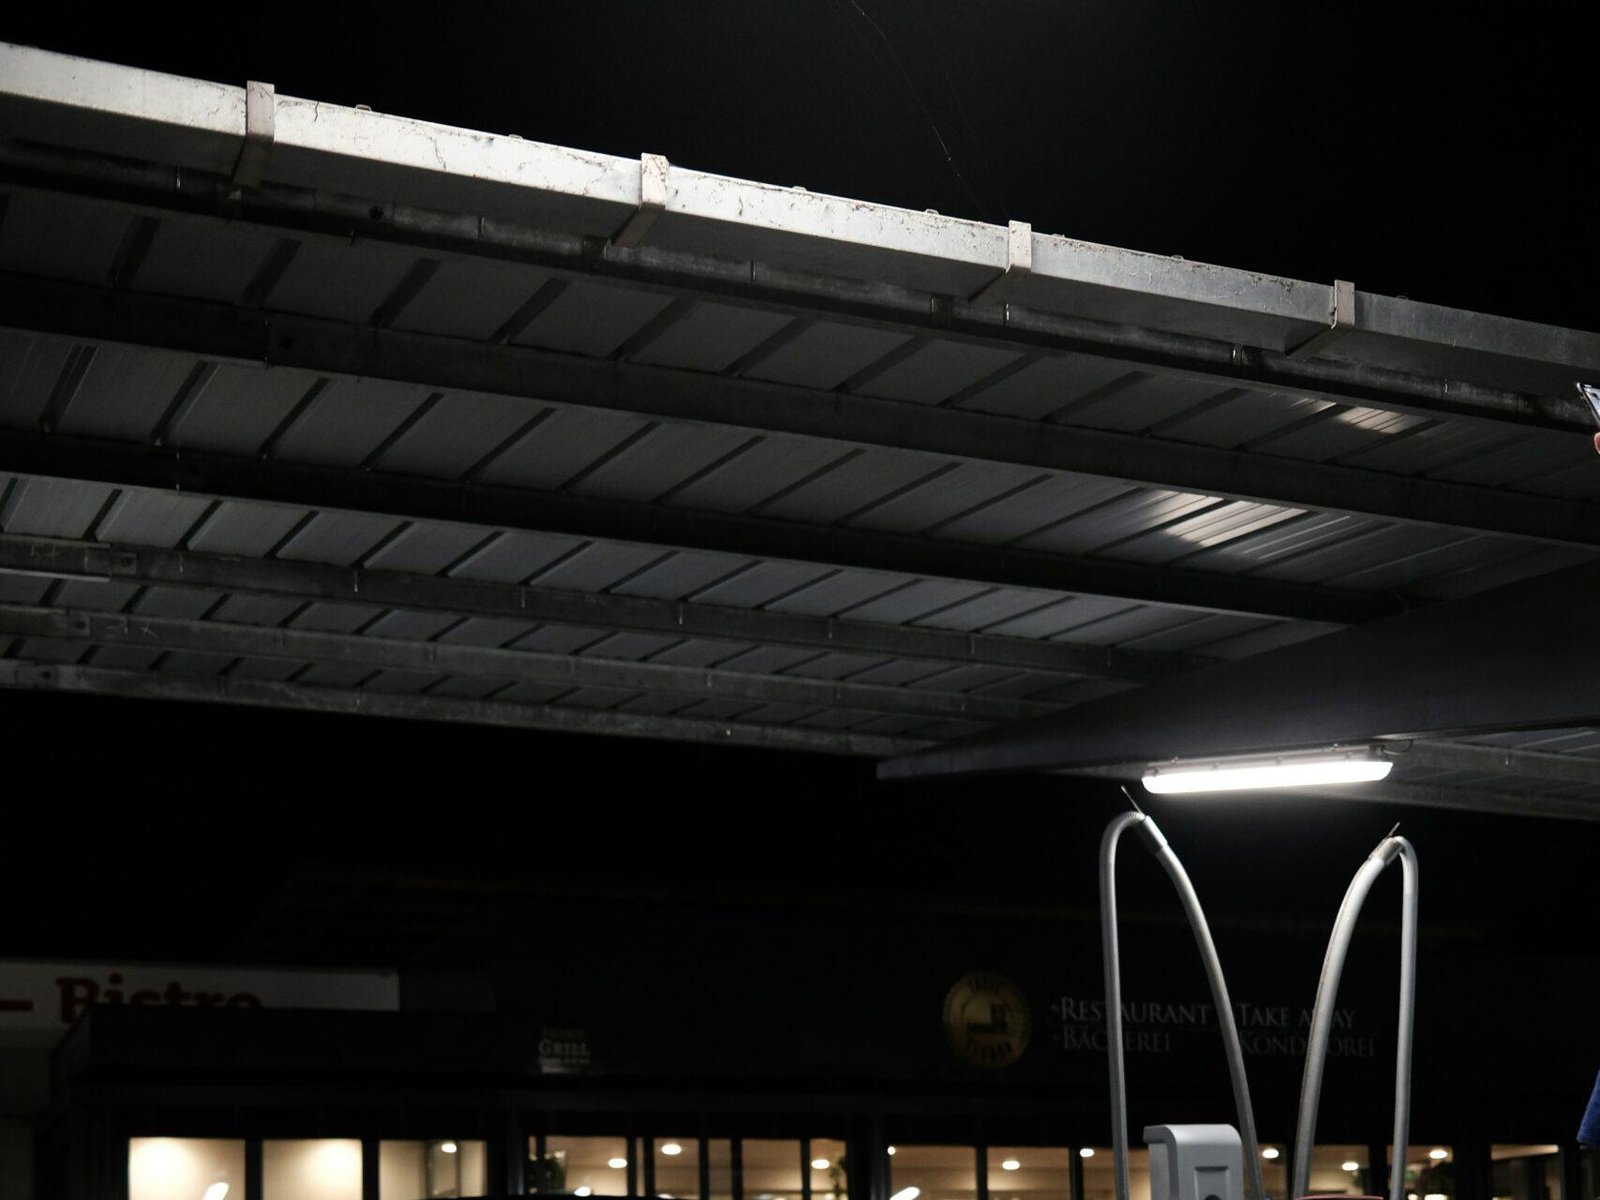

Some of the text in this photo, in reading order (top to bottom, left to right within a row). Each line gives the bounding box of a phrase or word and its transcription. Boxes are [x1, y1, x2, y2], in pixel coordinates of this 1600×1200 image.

[1061, 996, 1356, 1030] RESAURANT TAKE AAY
[1239, 1030, 1375, 1057] KONDOREI
